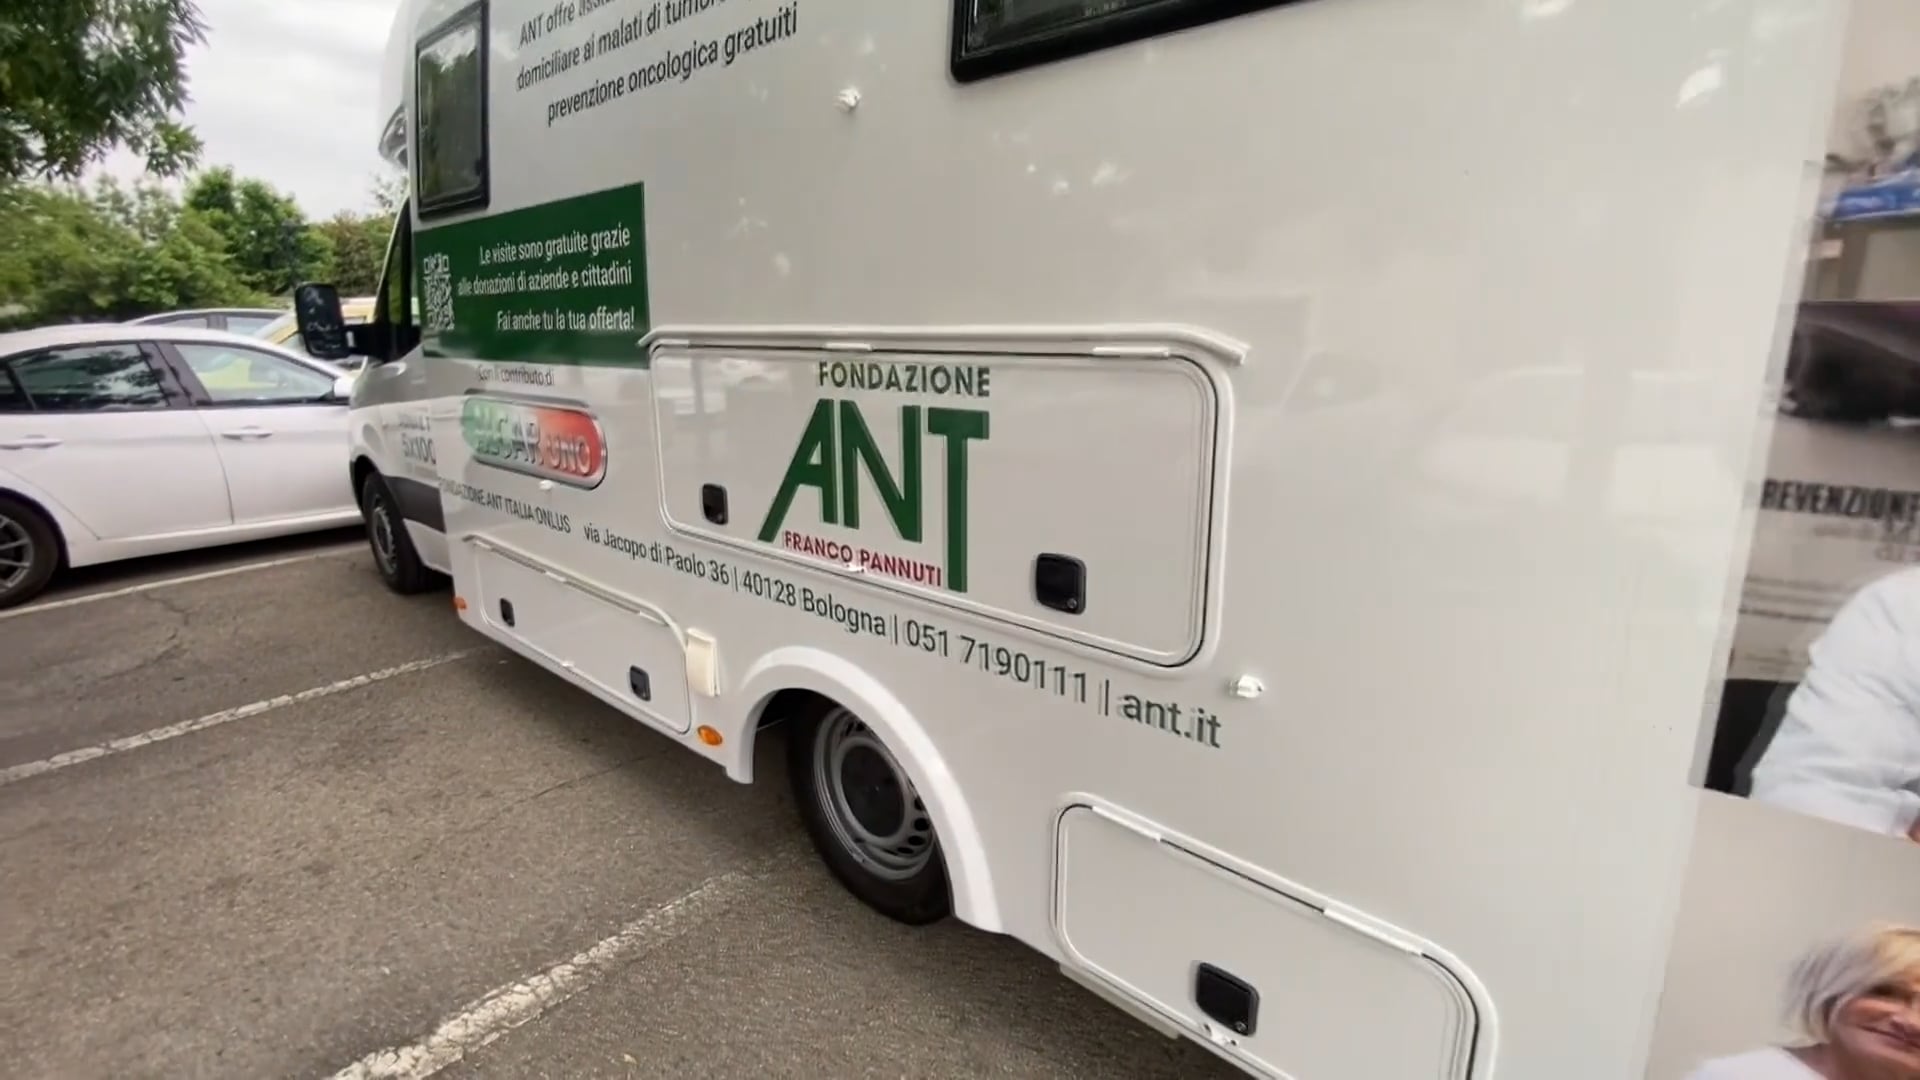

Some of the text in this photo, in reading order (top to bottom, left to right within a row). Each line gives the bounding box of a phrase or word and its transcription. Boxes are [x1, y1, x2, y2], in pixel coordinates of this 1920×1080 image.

[516, 52, 580, 91] domiciliare
[598, 10, 643, 56] malati
[646, 3, 661, 36] di
[518, 20, 545, 49] ANT
[546, 2, 575, 34] offre
[547, 1, 797, 126] prevenzione oncologica gratuiti
[480, 221, 631, 265] Le visite sono gratuite grazie
[473, 274, 516, 295] donazioni
[517, 270, 527, 291] di
[528, 265, 569, 290] aziende
[571, 272, 578, 288] e
[581, 259, 632, 287] cittadini
[497, 305, 635, 330] Fai anche tu la tua offerta!
[501, 366, 544, 386] contributo
[545, 368, 555, 386] di
[818, 361, 990, 397] FONDAZIONE
[757, 398, 990, 593] ANT
[783, 530, 942, 587] FRANCO PANNUTI
[487, 492, 503, 511] ANT
[505, 497, 534, 522] ITALIA
[535, 506, 571, 534] ONLUS
[584, 522, 600, 543] via
[603, 529, 648, 560] Jacopo
[651, 541, 663, 564] di
[665, 545, 706, 578] Paolo
[709, 559, 730, 585] 36
[743, 570, 797, 608] 40128
[801, 587, 886, 634] Bologna
[906, 619, 949, 657] 051
[957, 634, 1086, 704] 7190111
[1120, 692, 1222, 749] ant.it
